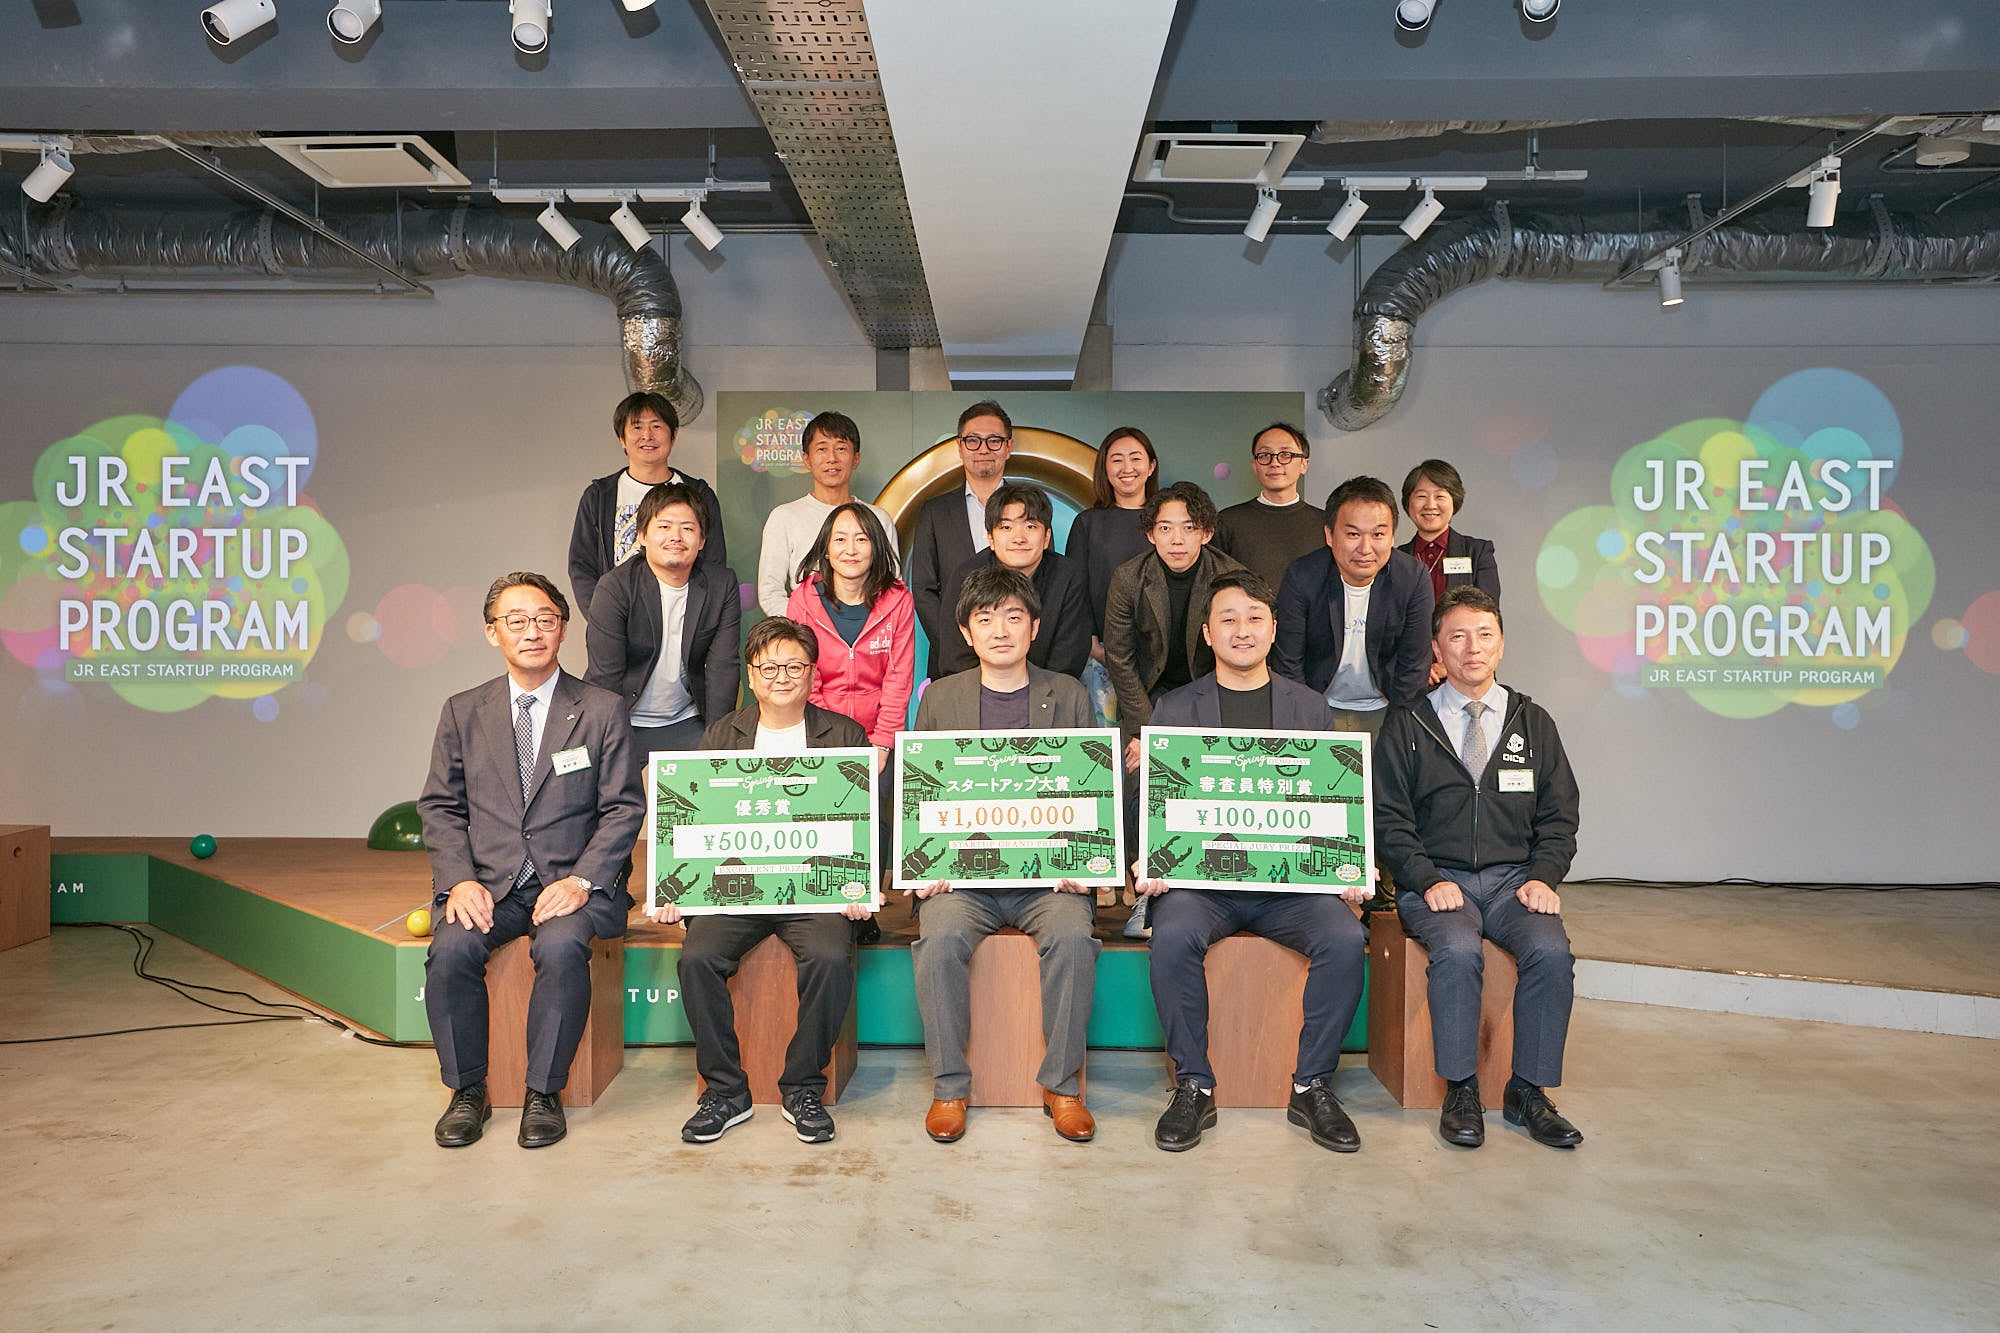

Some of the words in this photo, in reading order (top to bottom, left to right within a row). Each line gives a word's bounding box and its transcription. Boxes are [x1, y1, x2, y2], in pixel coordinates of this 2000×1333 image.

[756, 418, 773, 431] JR
[56, 456, 132, 507] JR
[162, 456, 310, 507] EAST
[1633, 460, 1709, 512] JR
[1739, 460, 1894, 512] EAST
[57, 527, 309, 579] STARTUP
[1633, 531, 1891, 584] STARTUP
[59, 599, 309, 651] PROGRAM
[1635, 604, 1892, 658] PROGRAM
[73, 663, 94, 677] JR
[99, 663, 141, 677] EAST
[146, 663, 215, 677] STARTUP
[220, 663, 294, 677] PROGRAM
[1649, 669, 1670, 682] JR
[1675, 669, 1717, 682] EAST
[1723, 669, 1793, 683] STARTUP
[1799, 670, 1875, 684] PROGRAM
[906, 743, 923, 752] JR
[1152, 738, 1169, 748] JR
[661, 763, 677, 773] JR
[987, 754, 1018, 772] Spring
[1235, 753, 1266, 772] Spring
[742, 776, 774, 794] Spring
[946, 776, 1071, 793] スタートアップ大賞
[1199, 776, 1313, 796] 審査員特別賞
[734, 799, 791, 817] 優秀賞
[938, 805, 1075, 829] ¥1,000,000
[1196, 806, 1311, 830] ¥100,000
[704, 829, 819, 852] ¥500,000
[1205, 841, 1247, 850] SPECIAL
[1249, 842, 1275, 851] JURY
[1279, 844, 1309, 852] PRIZE
